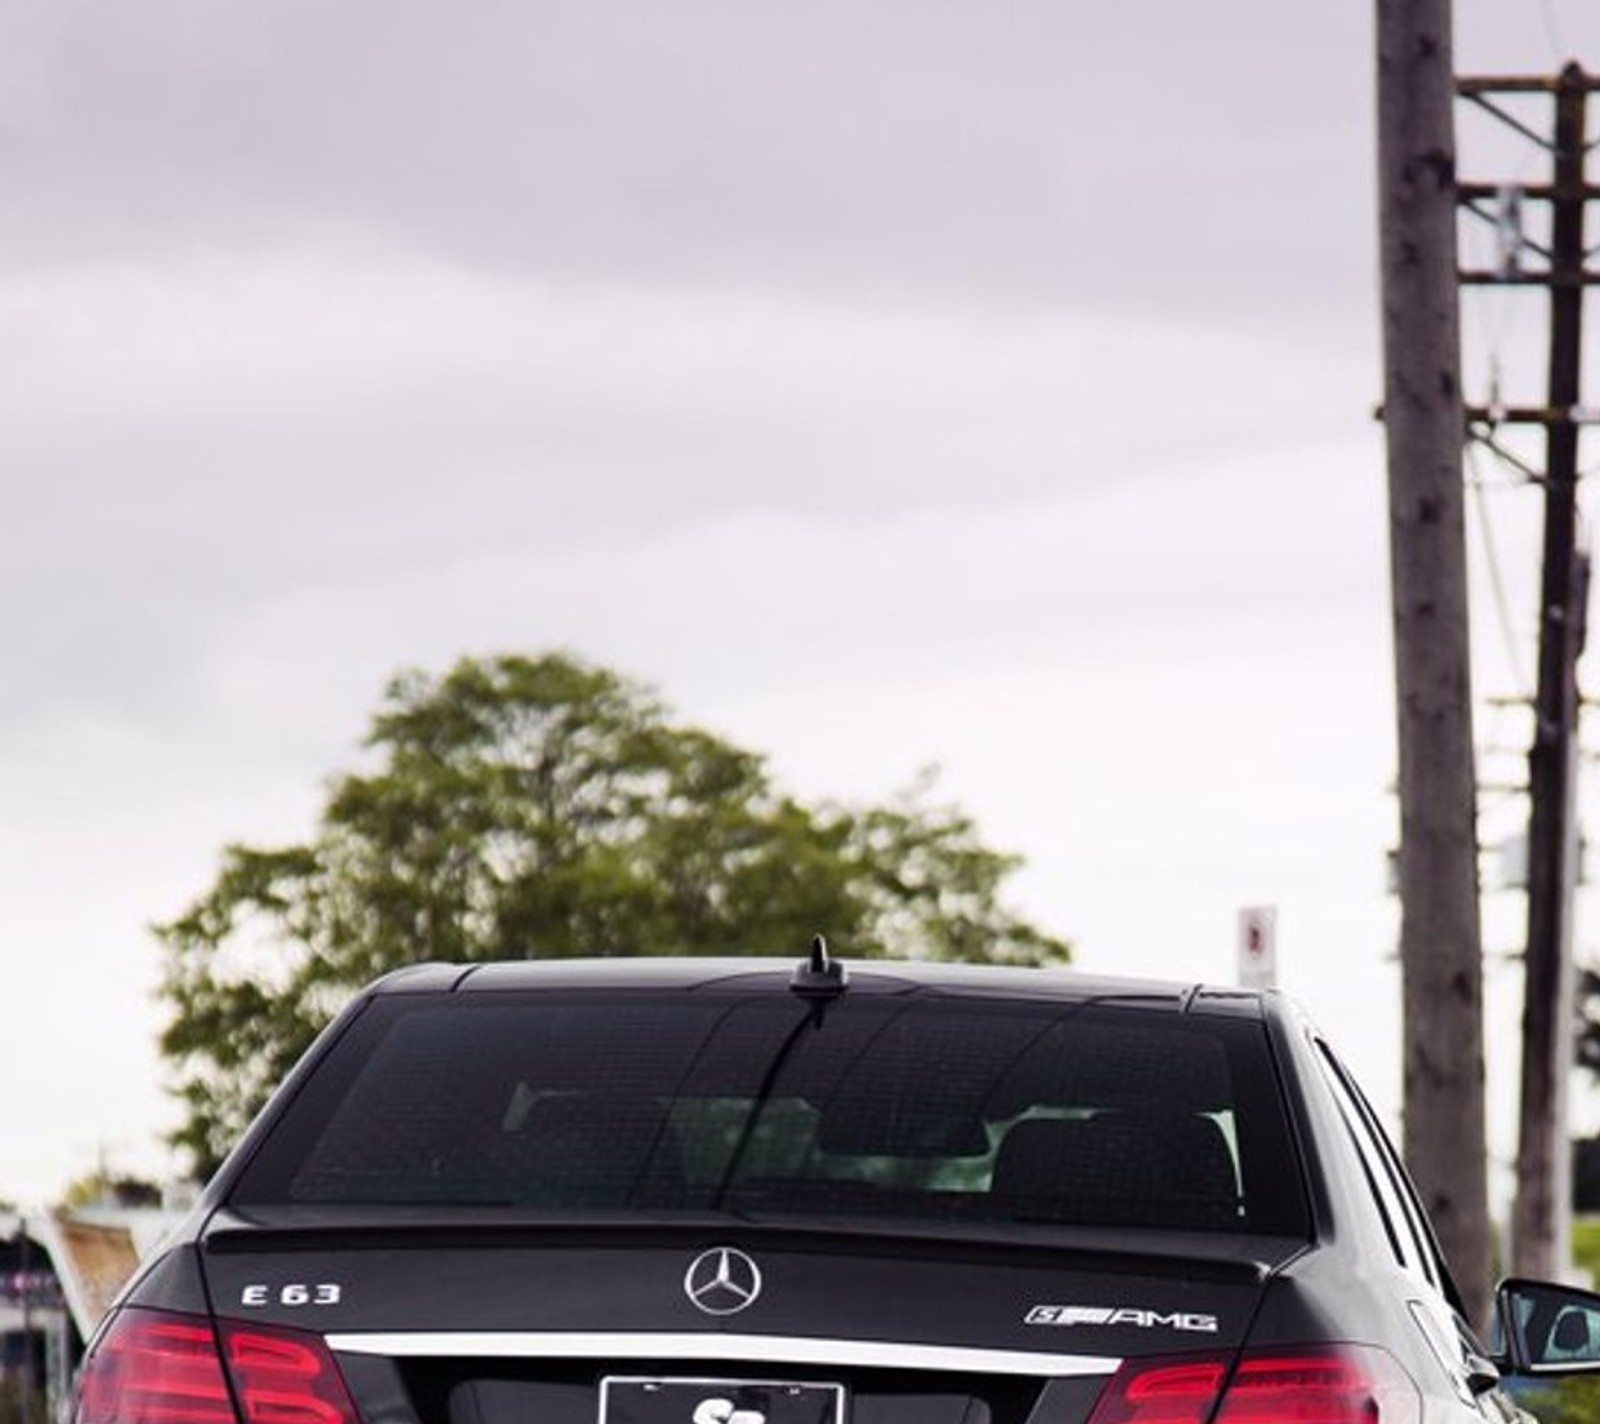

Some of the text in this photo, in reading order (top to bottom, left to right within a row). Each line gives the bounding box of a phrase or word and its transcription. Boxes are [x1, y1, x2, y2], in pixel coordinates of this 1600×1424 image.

[241, 1284, 341, 1305] E 63
[1108, 1308, 1218, 1332] AMG
